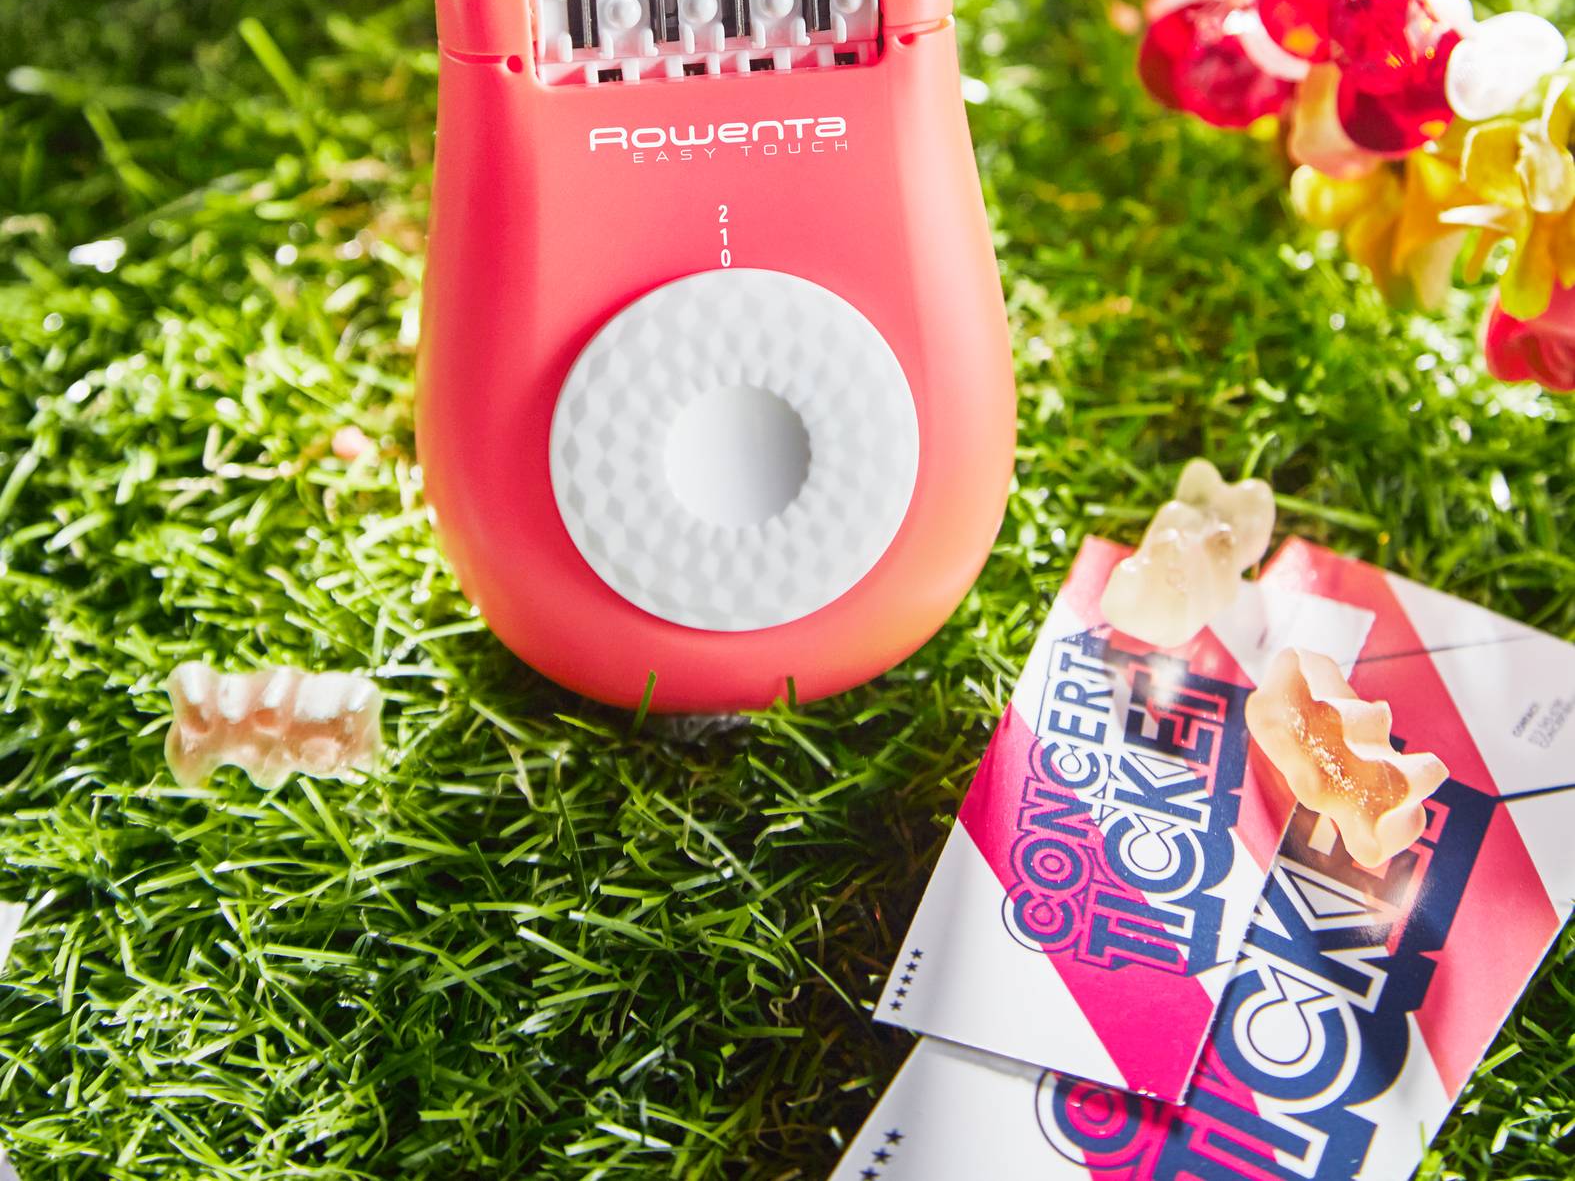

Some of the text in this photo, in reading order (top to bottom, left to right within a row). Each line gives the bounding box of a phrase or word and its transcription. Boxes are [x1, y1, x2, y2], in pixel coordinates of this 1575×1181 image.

[633, 140, 848, 164] EASY TOUCH
[718, 204, 729, 223] 2
[719, 227, 728, 246] 1
[720, 249, 732, 267] 0
[1006, 647, 1116, 951] CONCERT
[1080, 664, 1232, 974] TICKET
